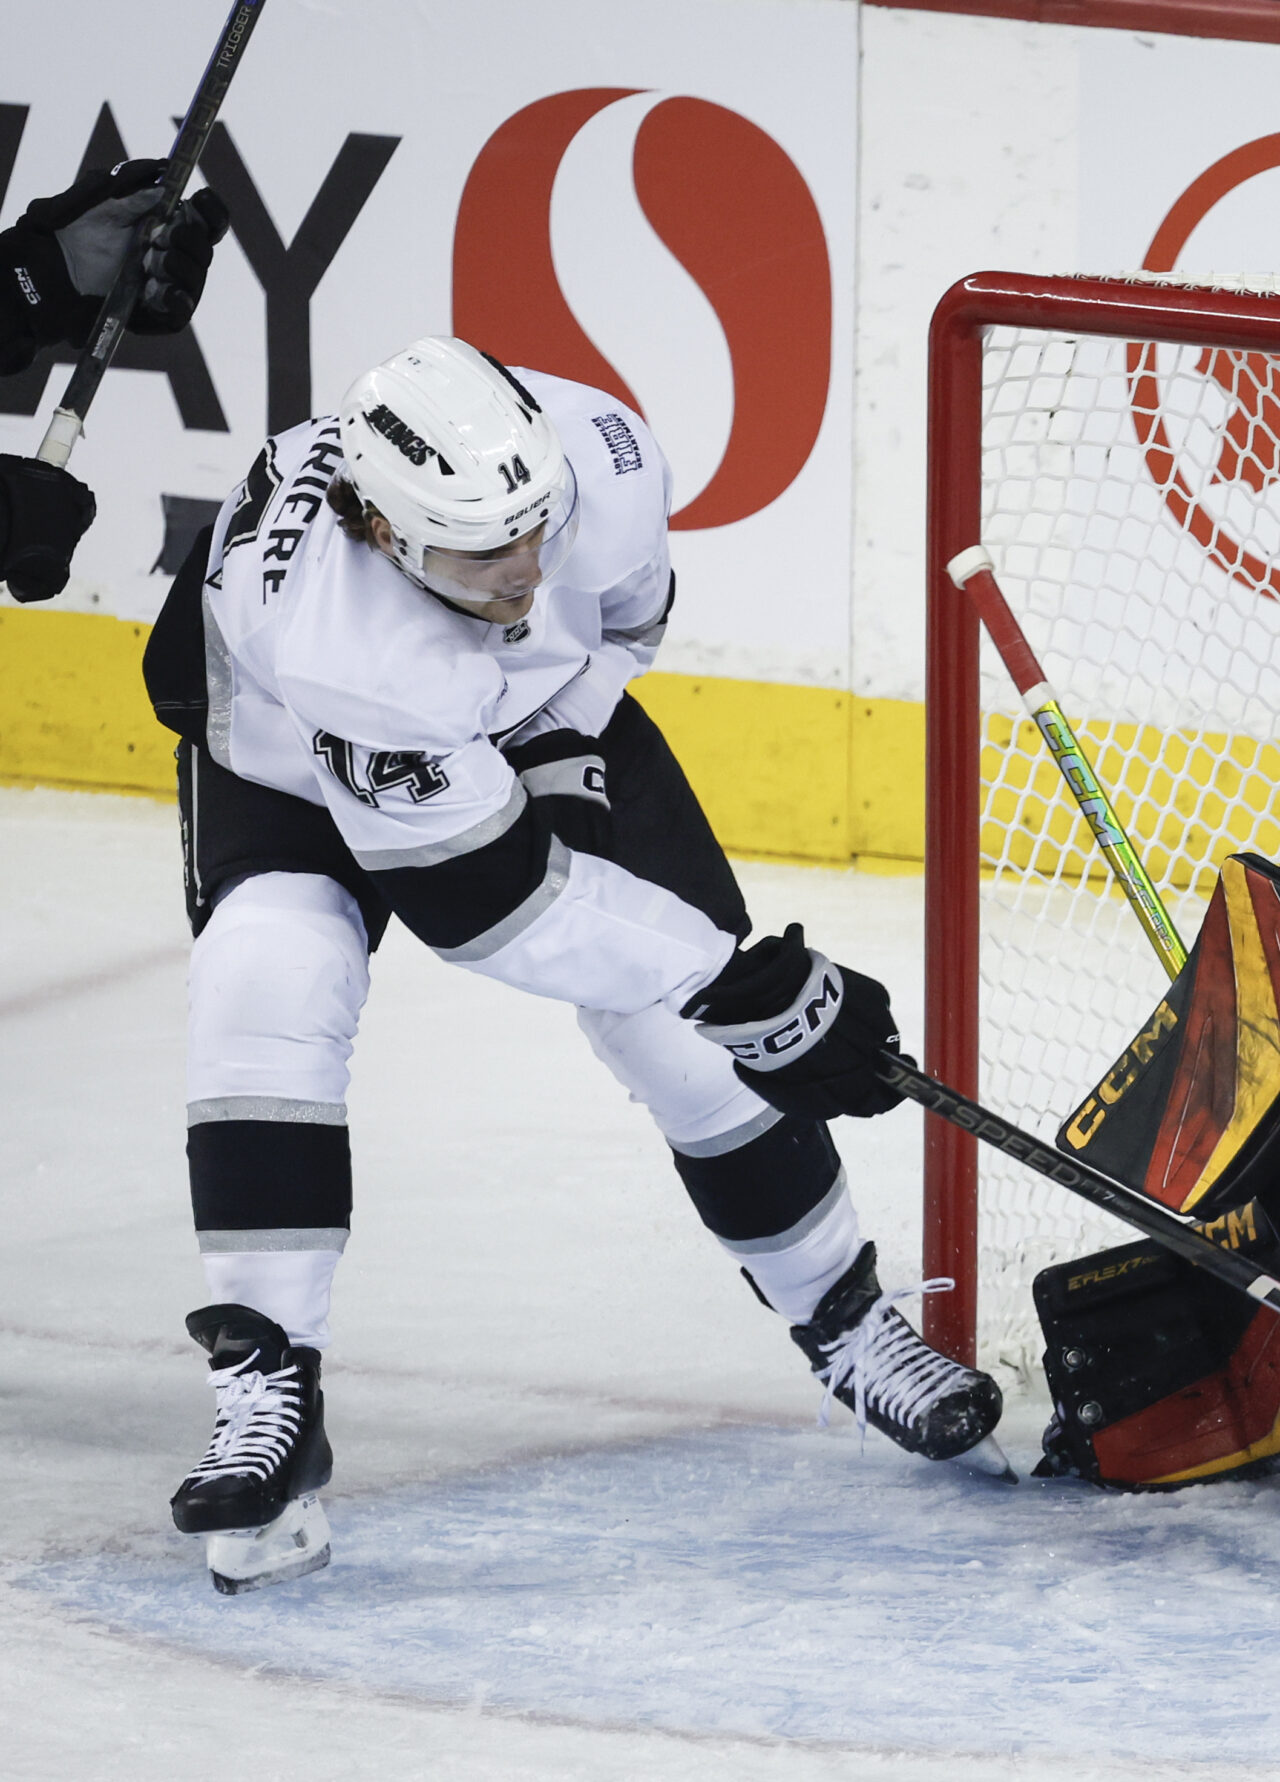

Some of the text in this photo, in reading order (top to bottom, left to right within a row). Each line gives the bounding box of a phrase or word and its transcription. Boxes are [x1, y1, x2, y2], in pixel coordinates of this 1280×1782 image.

[216, 6, 252, 69] TRIGGER
[498, 453, 531, 495] 14
[599, 413, 638, 474] FIRE
[313, 729, 450, 809] 14
[1036, 710, 1125, 848] CCM
[1150, 912, 1175, 951] PRO
[722, 971, 841, 1061] CCM
[1065, 1000, 1178, 1150] CCM
[874, 1065, 1081, 1187] JETSPEED
[1194, 1202, 1257, 1265] CM
